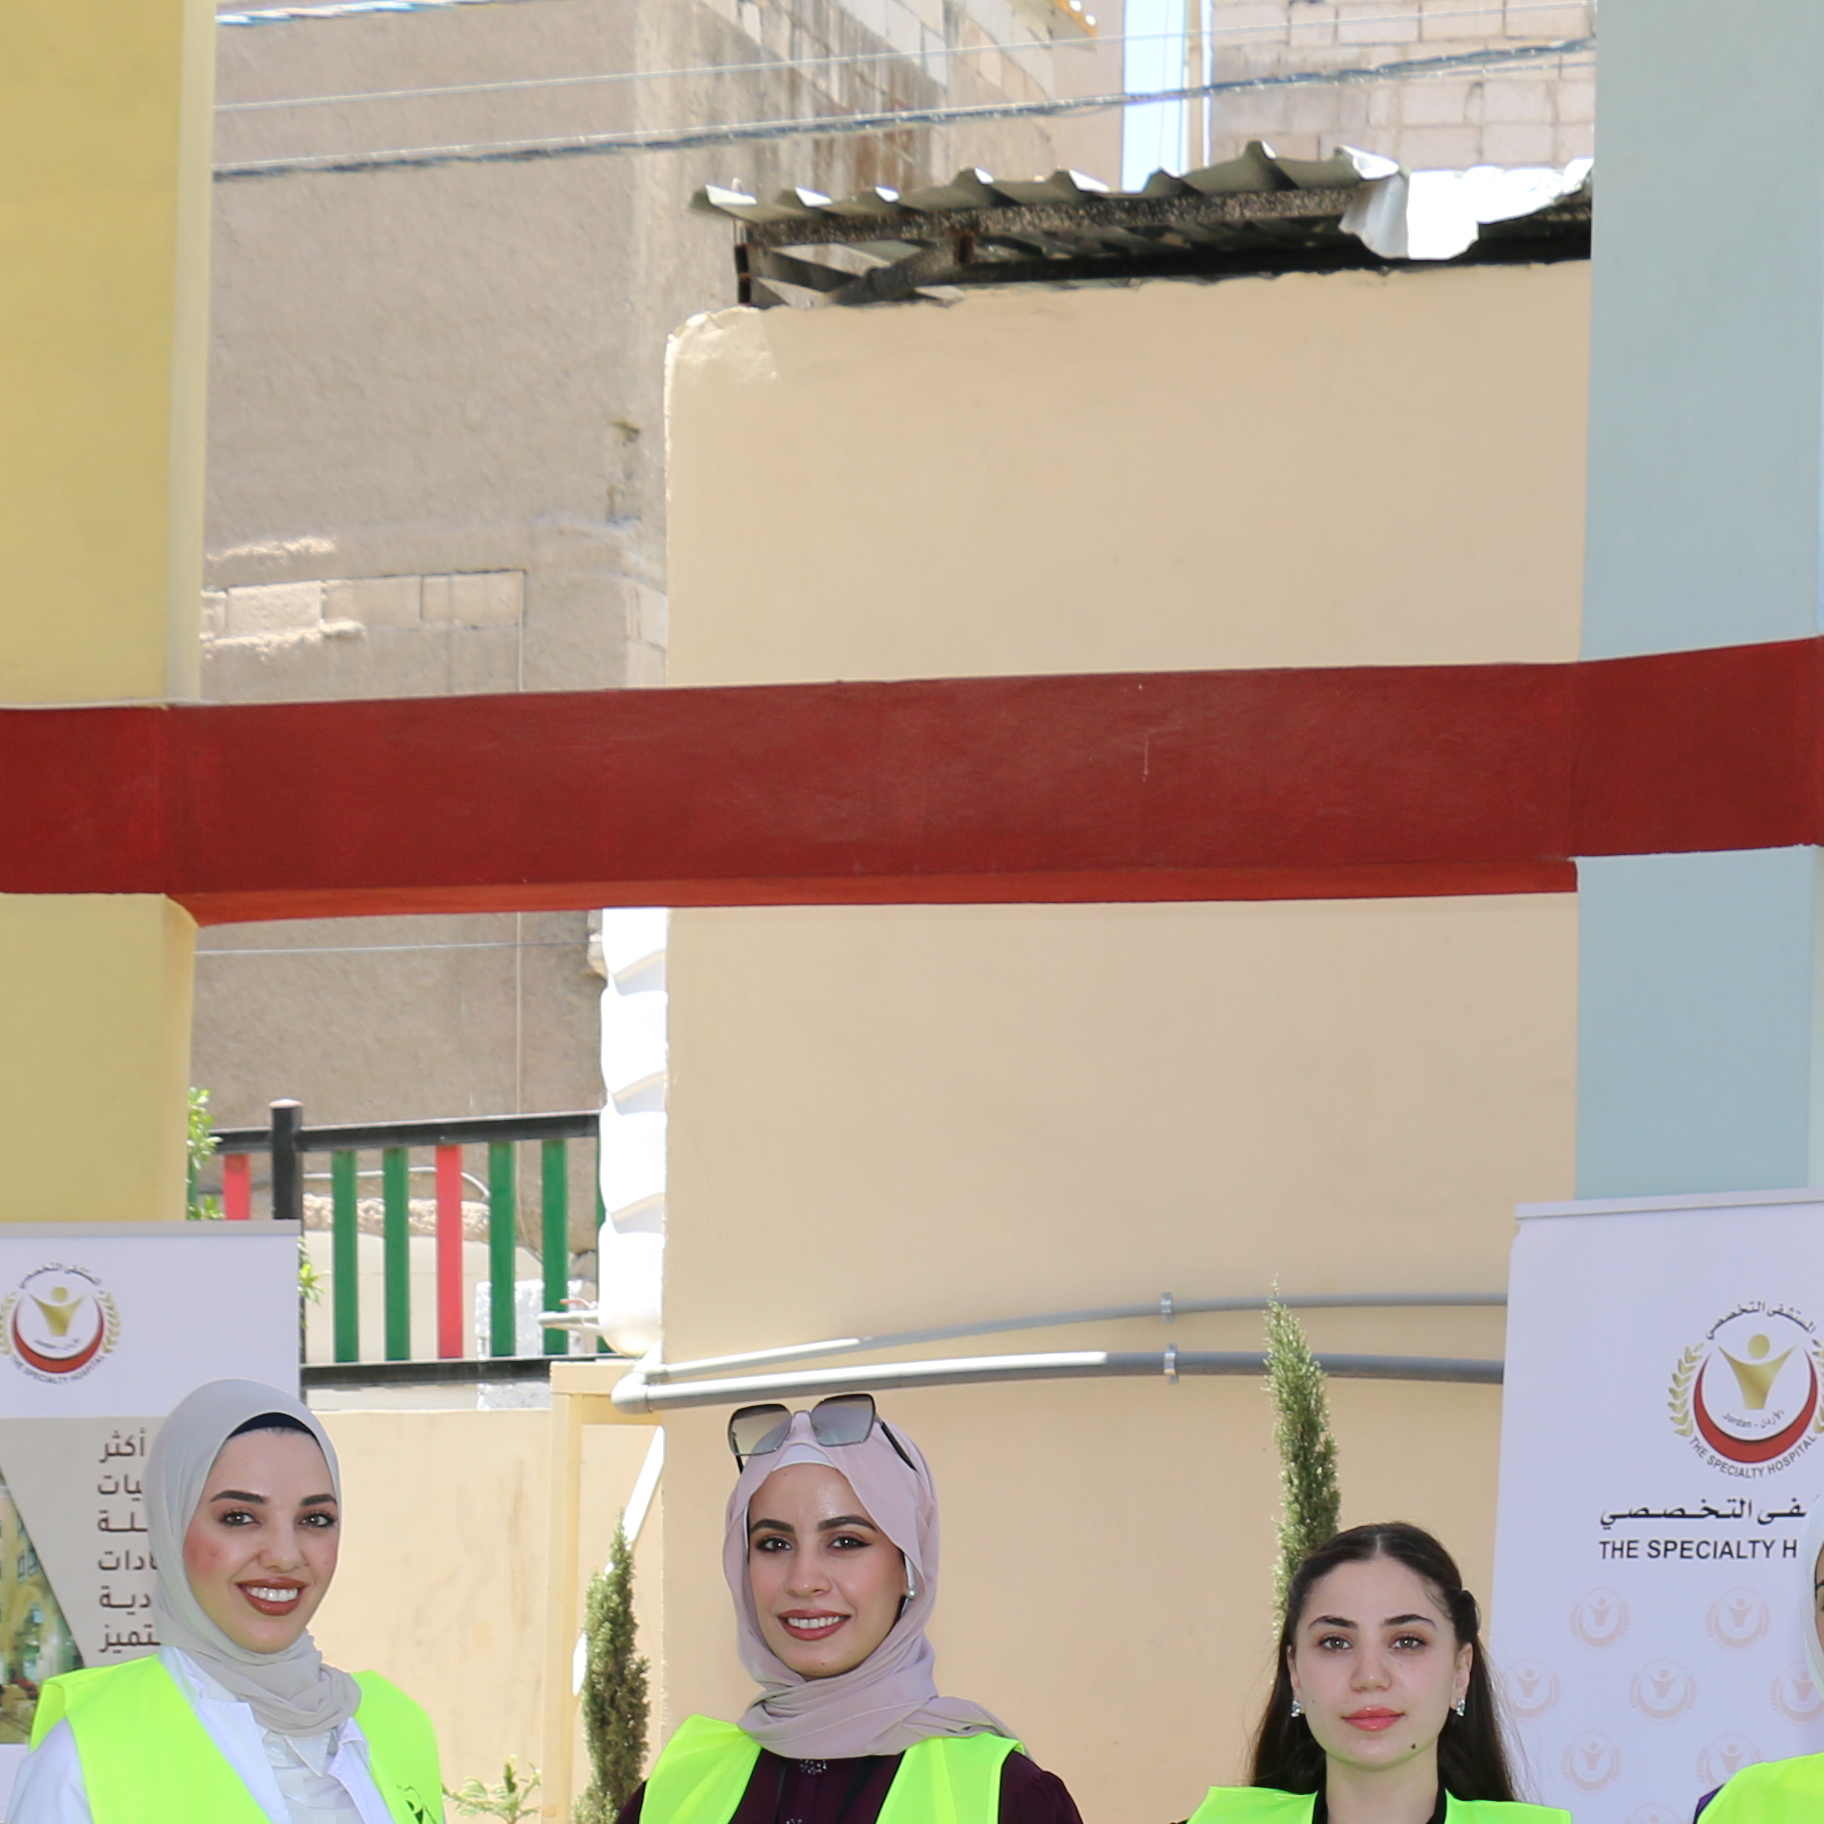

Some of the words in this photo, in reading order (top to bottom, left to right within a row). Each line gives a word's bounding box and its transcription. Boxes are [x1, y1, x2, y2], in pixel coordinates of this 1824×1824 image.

[1722, 1412, 1752, 1429] Jordan
[98, 1427, 146, 1463] أكثر
[1688, 1435, 1708, 1458] THE
[1706, 1454, 1765, 1479] SPECIALTY
[1766, 1435, 1817, 1475] HOSPITAL
[1600, 1497, 1753, 1530] التخصصي
[1599, 1539, 1640, 1560] THE
[1646, 1538, 1777, 1560] SPECIALTY
